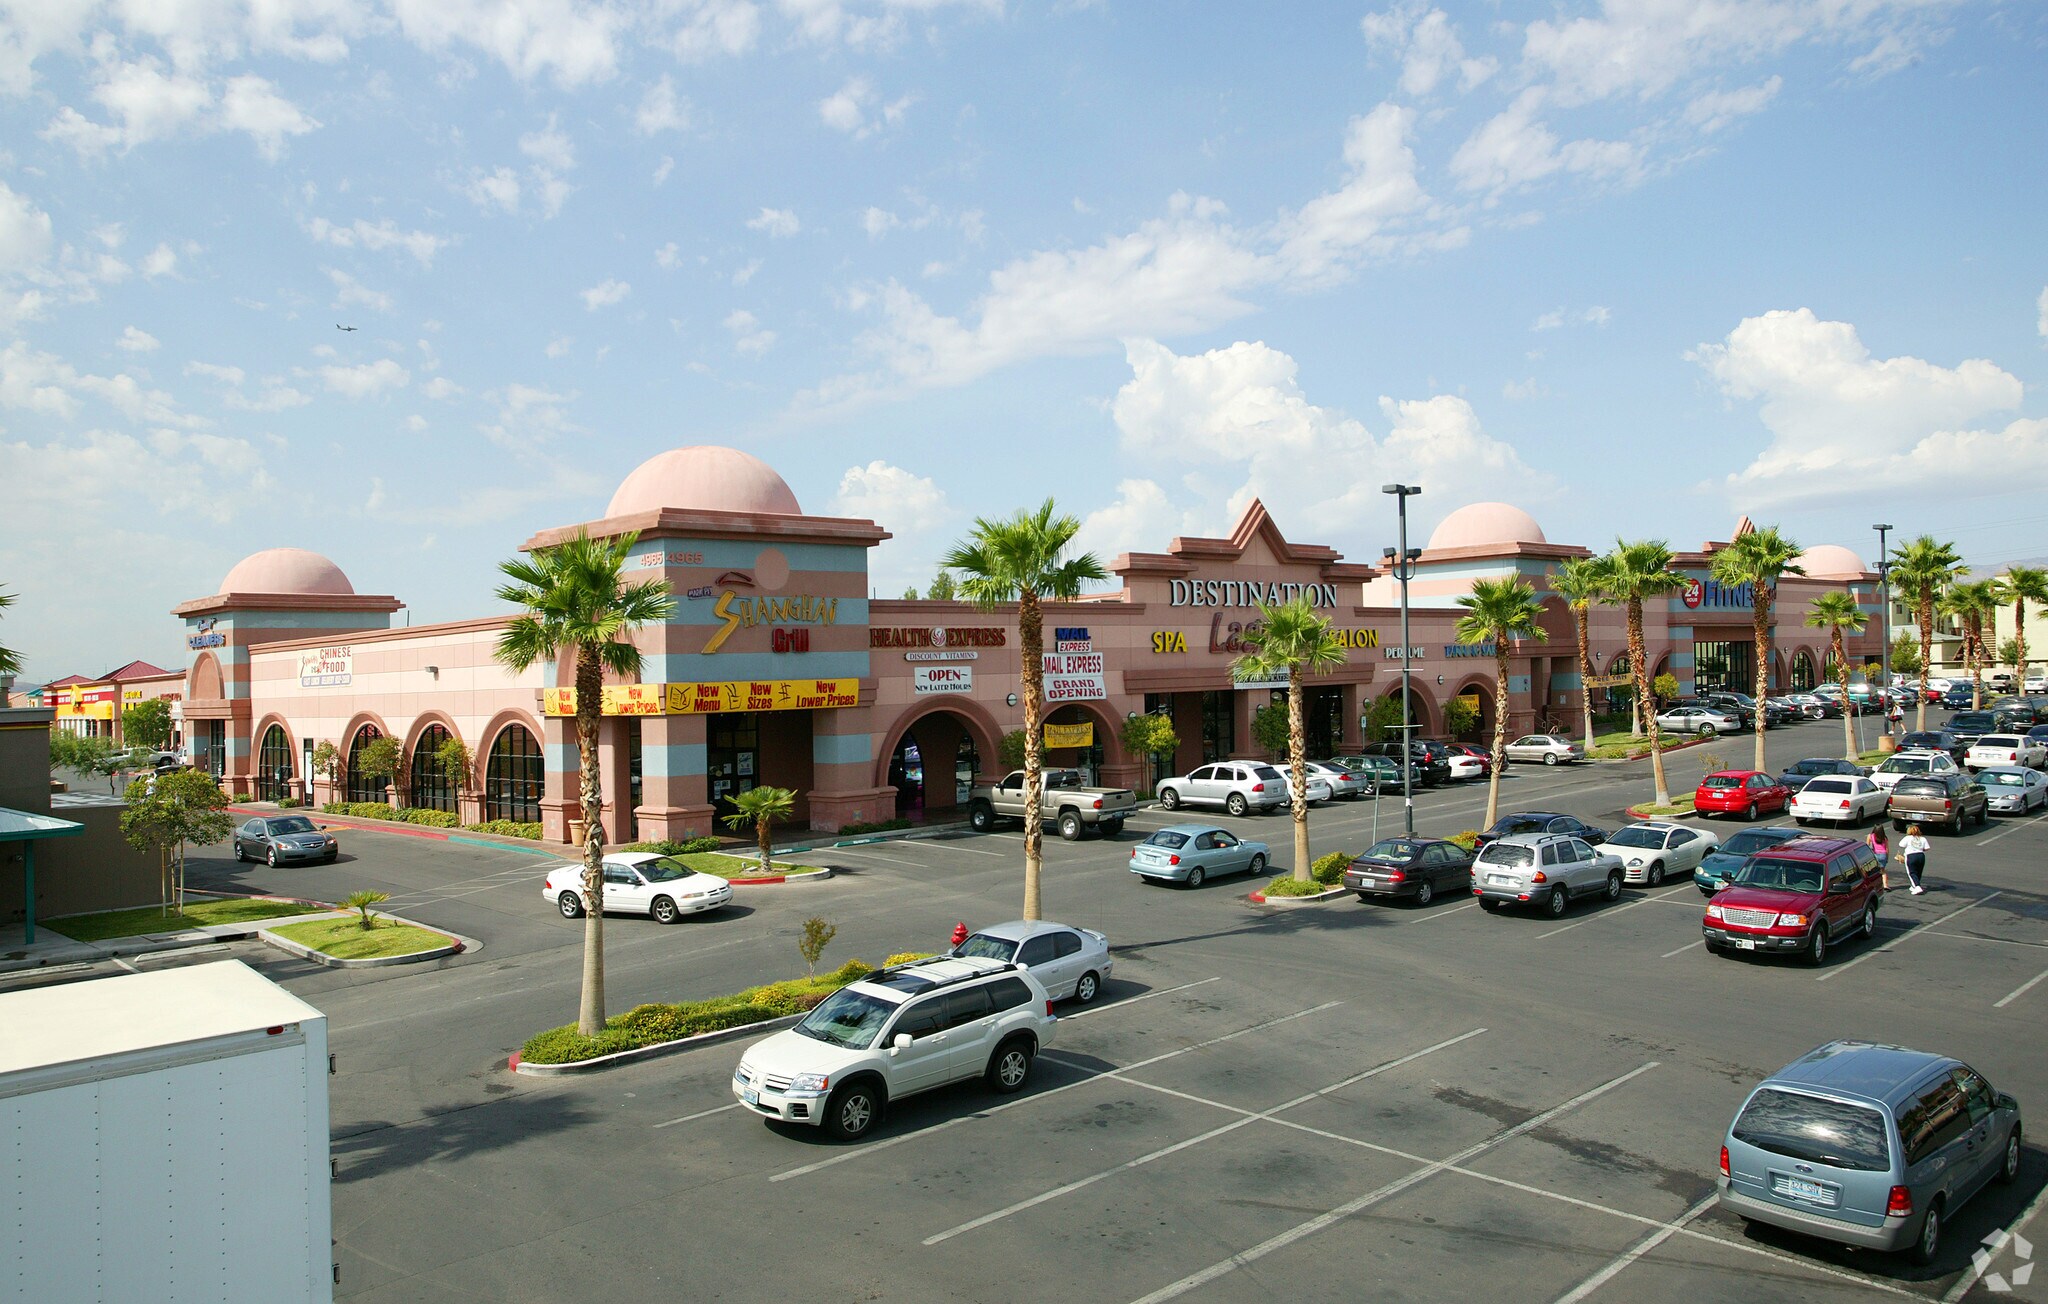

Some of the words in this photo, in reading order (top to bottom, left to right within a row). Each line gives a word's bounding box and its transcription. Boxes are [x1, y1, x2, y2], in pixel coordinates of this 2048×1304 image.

[641, 552, 663, 566] 4965
[666, 551, 705, 564] 4965
[1170, 579, 1338, 608] DESTINATION
[1684, 584, 1699, 597] 24
[870, 627, 929, 648] HEALTH
[945, 627, 1006, 647] EXPRESS
[1056, 628, 1091, 640] MAIL
[1329, 629, 1379, 649] SALON
[189, 633, 225, 649] CLEANERS
[772, 628, 809, 653] Grill
[1060, 642, 1090, 651] EXPRESS
[1153, 631, 1187, 653] SPA
[320, 647, 351, 659] CHINESE
[1385, 647, 1425, 658] PERUME
[326, 661, 345, 672] FOOD
[1044, 657, 1063, 674] MAIL
[1067, 656, 1102, 673] EXPRESS
[929, 670, 961, 681] OPEN
[751, 683, 771, 695] New
[816, 681, 836, 693] New
[1053, 680, 1095, 688] GRAND
[559, 689, 571, 701] New
[629, 687, 642, 699] New
[697, 684, 719, 697] New
[1049, 688, 1103, 698] OPENING
[694, 699, 720, 711] Menu
[748, 697, 772, 709] Sizes
[797, 695, 825, 707] Lower
[827, 694, 855, 706] Prices
[616, 702, 635, 714] Lower
[637, 700, 658, 713] Prices
